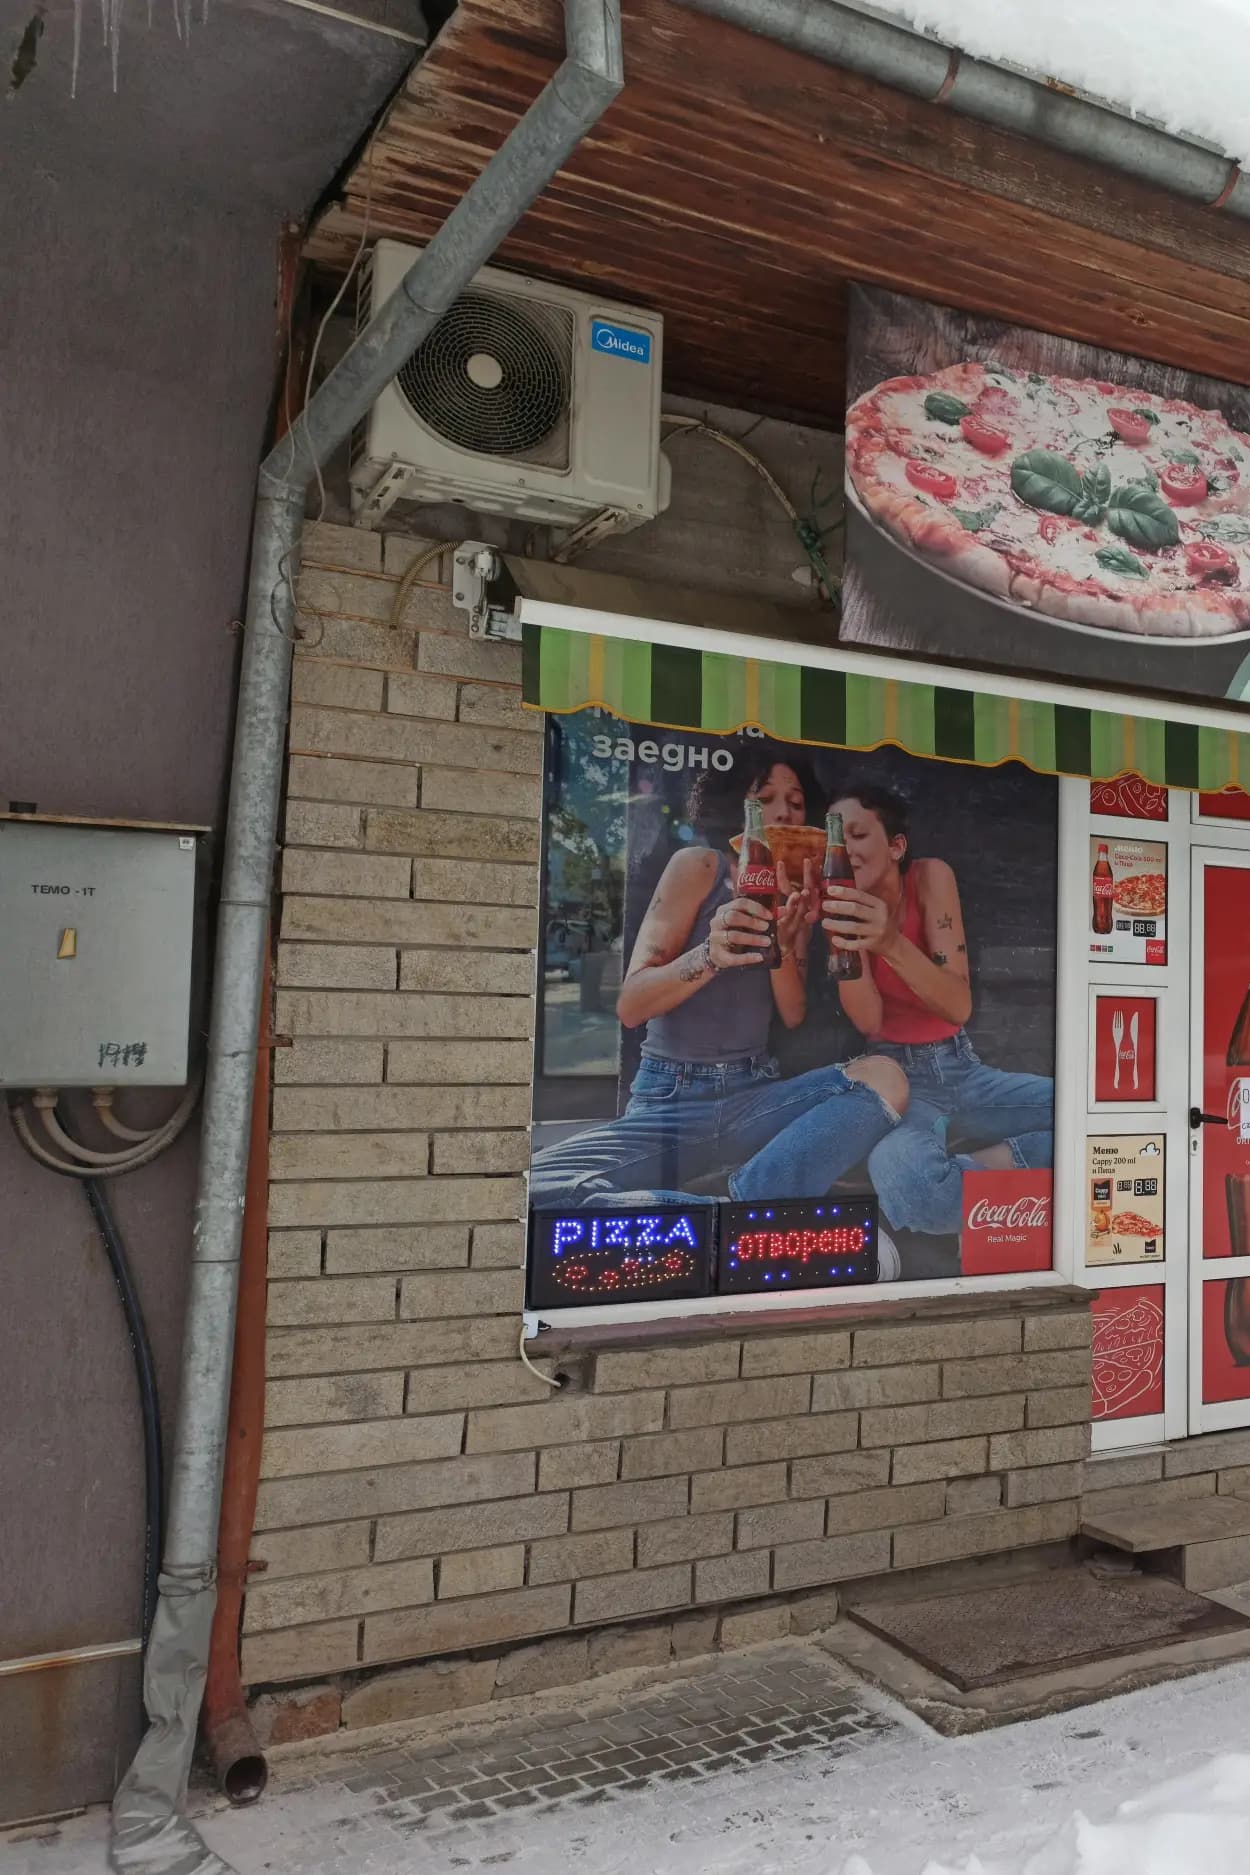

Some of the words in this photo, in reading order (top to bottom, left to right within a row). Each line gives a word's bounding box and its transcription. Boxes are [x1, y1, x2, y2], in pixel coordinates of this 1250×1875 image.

[600, 333, 645, 356] Midea
[591, 734, 734, 772] заедно
[737, 869, 775, 887] Coca-Cola
[1092, 1146, 1119, 1154] Меню
[1092, 1158, 1113, 1167] Cappy
[1113, 1157, 1126, 1165] 200
[967, 1196, 1050, 1230] Coca-Cola
[553, 1214, 699, 1256] PIZZA
[987, 1235, 1004, 1243] Real
[1005, 1234, 1027, 1243] Magic
